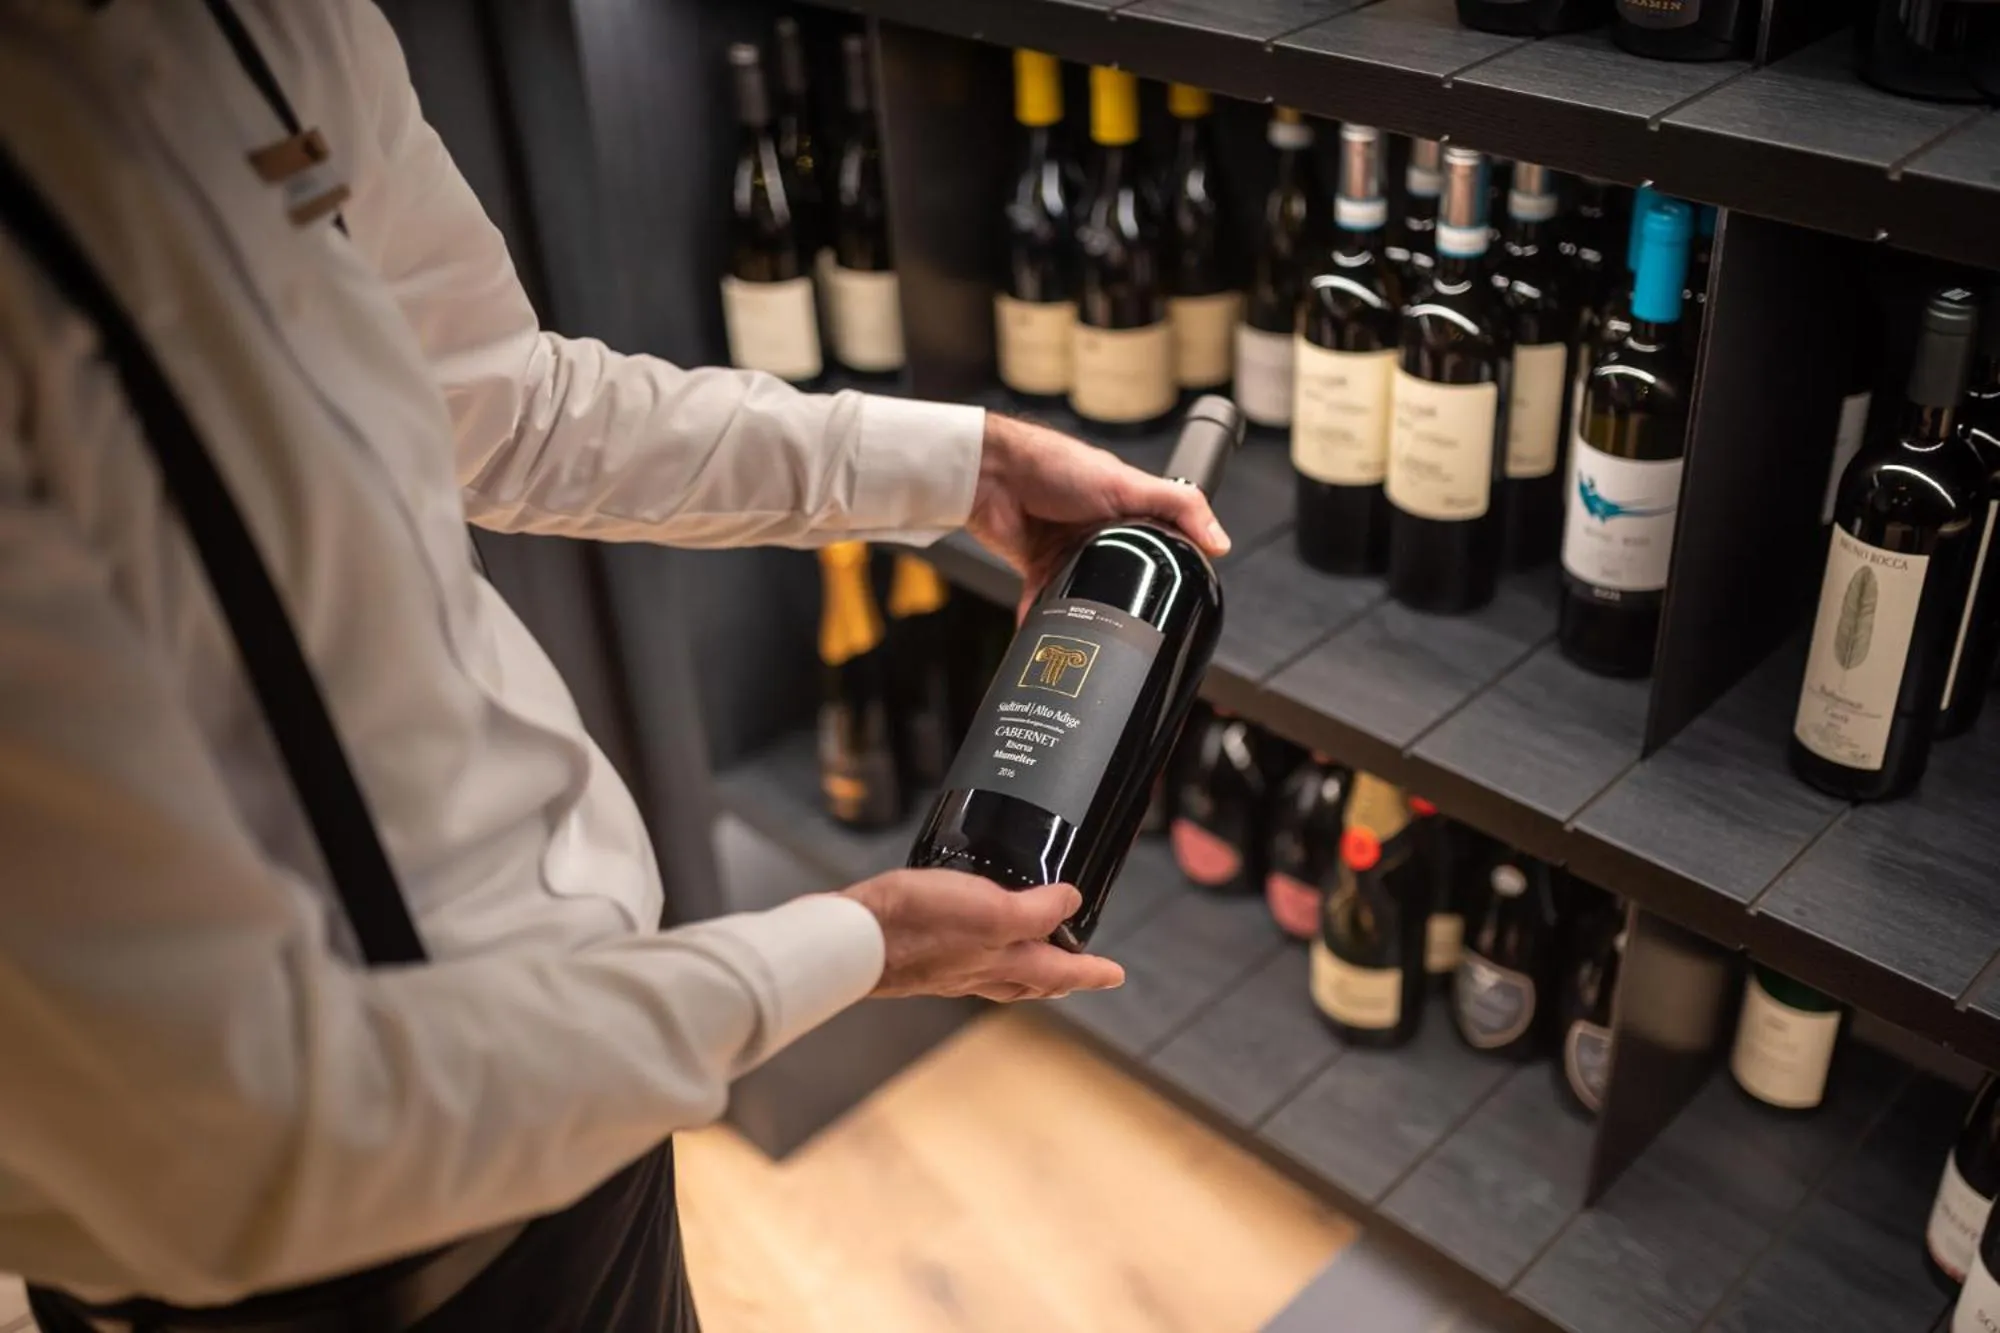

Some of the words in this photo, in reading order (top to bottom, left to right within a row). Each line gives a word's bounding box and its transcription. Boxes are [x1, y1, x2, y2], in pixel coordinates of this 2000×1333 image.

[1869, 552, 1909, 571] ROCCA
[1033, 704, 1055, 719] Alto
[1052, 710, 1081, 729] Adige
[994, 726, 1060, 748] CABERNET
[1004, 739, 1034, 753] Riserva
[993, 749, 1038, 766] Mumelter
